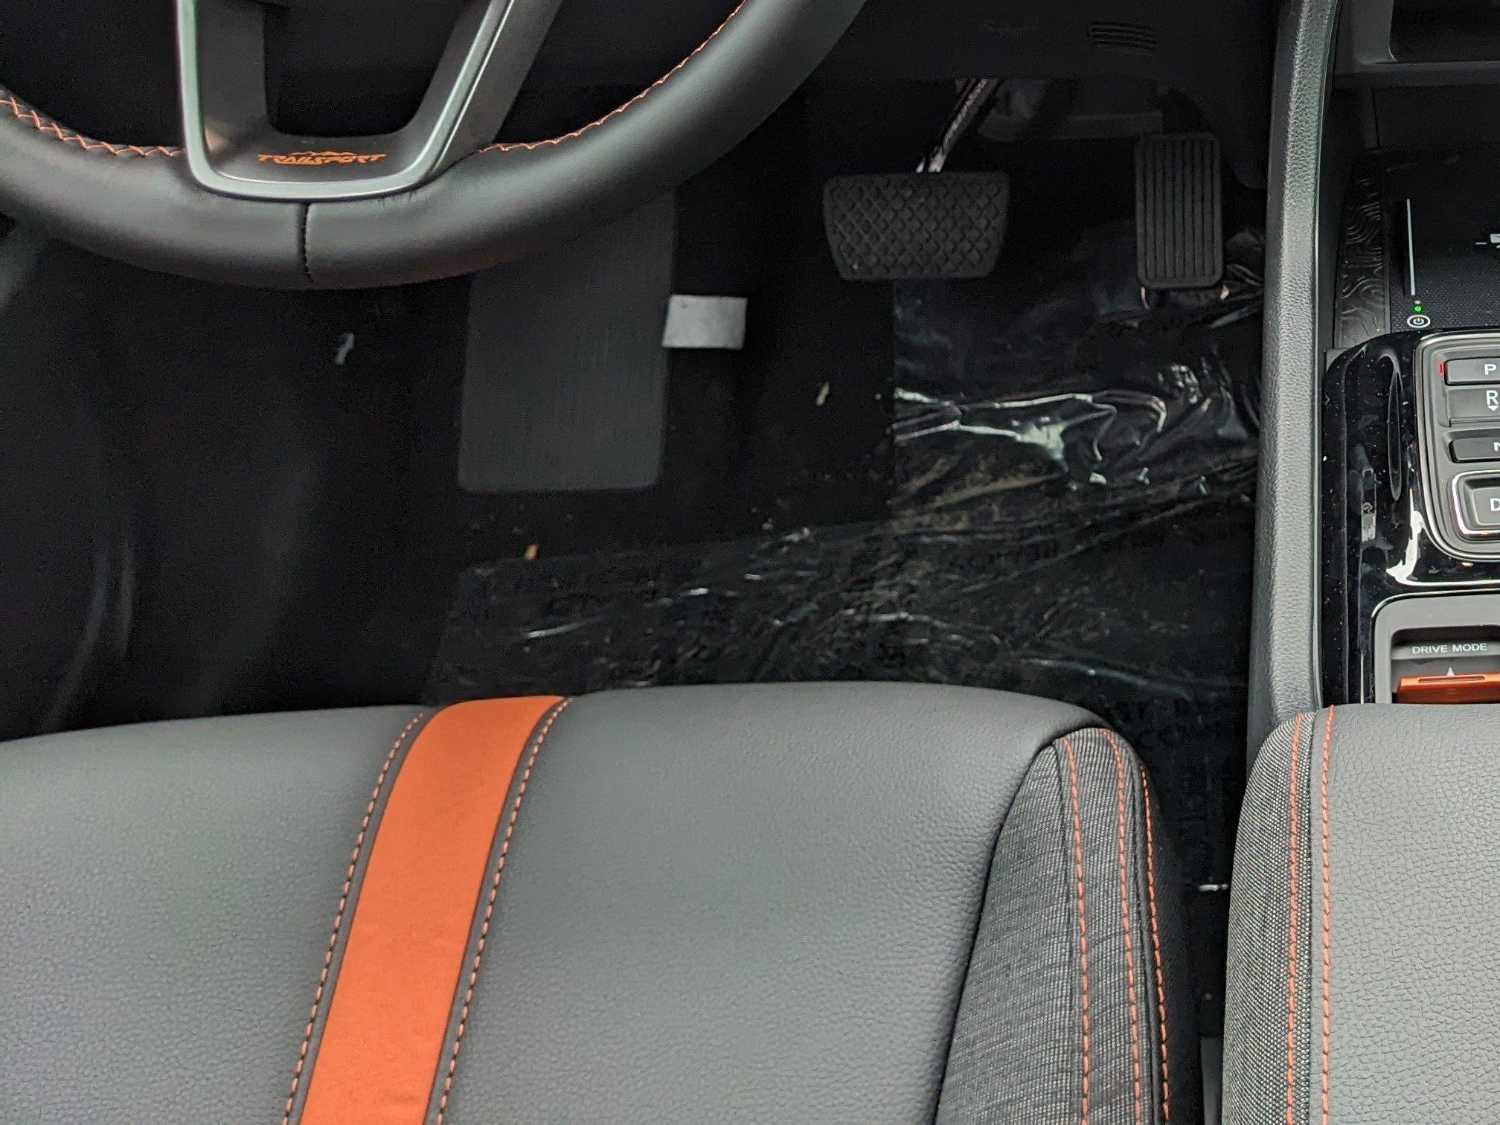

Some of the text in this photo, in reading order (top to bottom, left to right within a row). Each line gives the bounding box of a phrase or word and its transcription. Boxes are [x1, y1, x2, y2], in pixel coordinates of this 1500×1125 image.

[1484, 363, 1497, 375] P
[1485, 390, 1499, 406] R
[1412, 643, 1488, 654] DRIVE MODE
